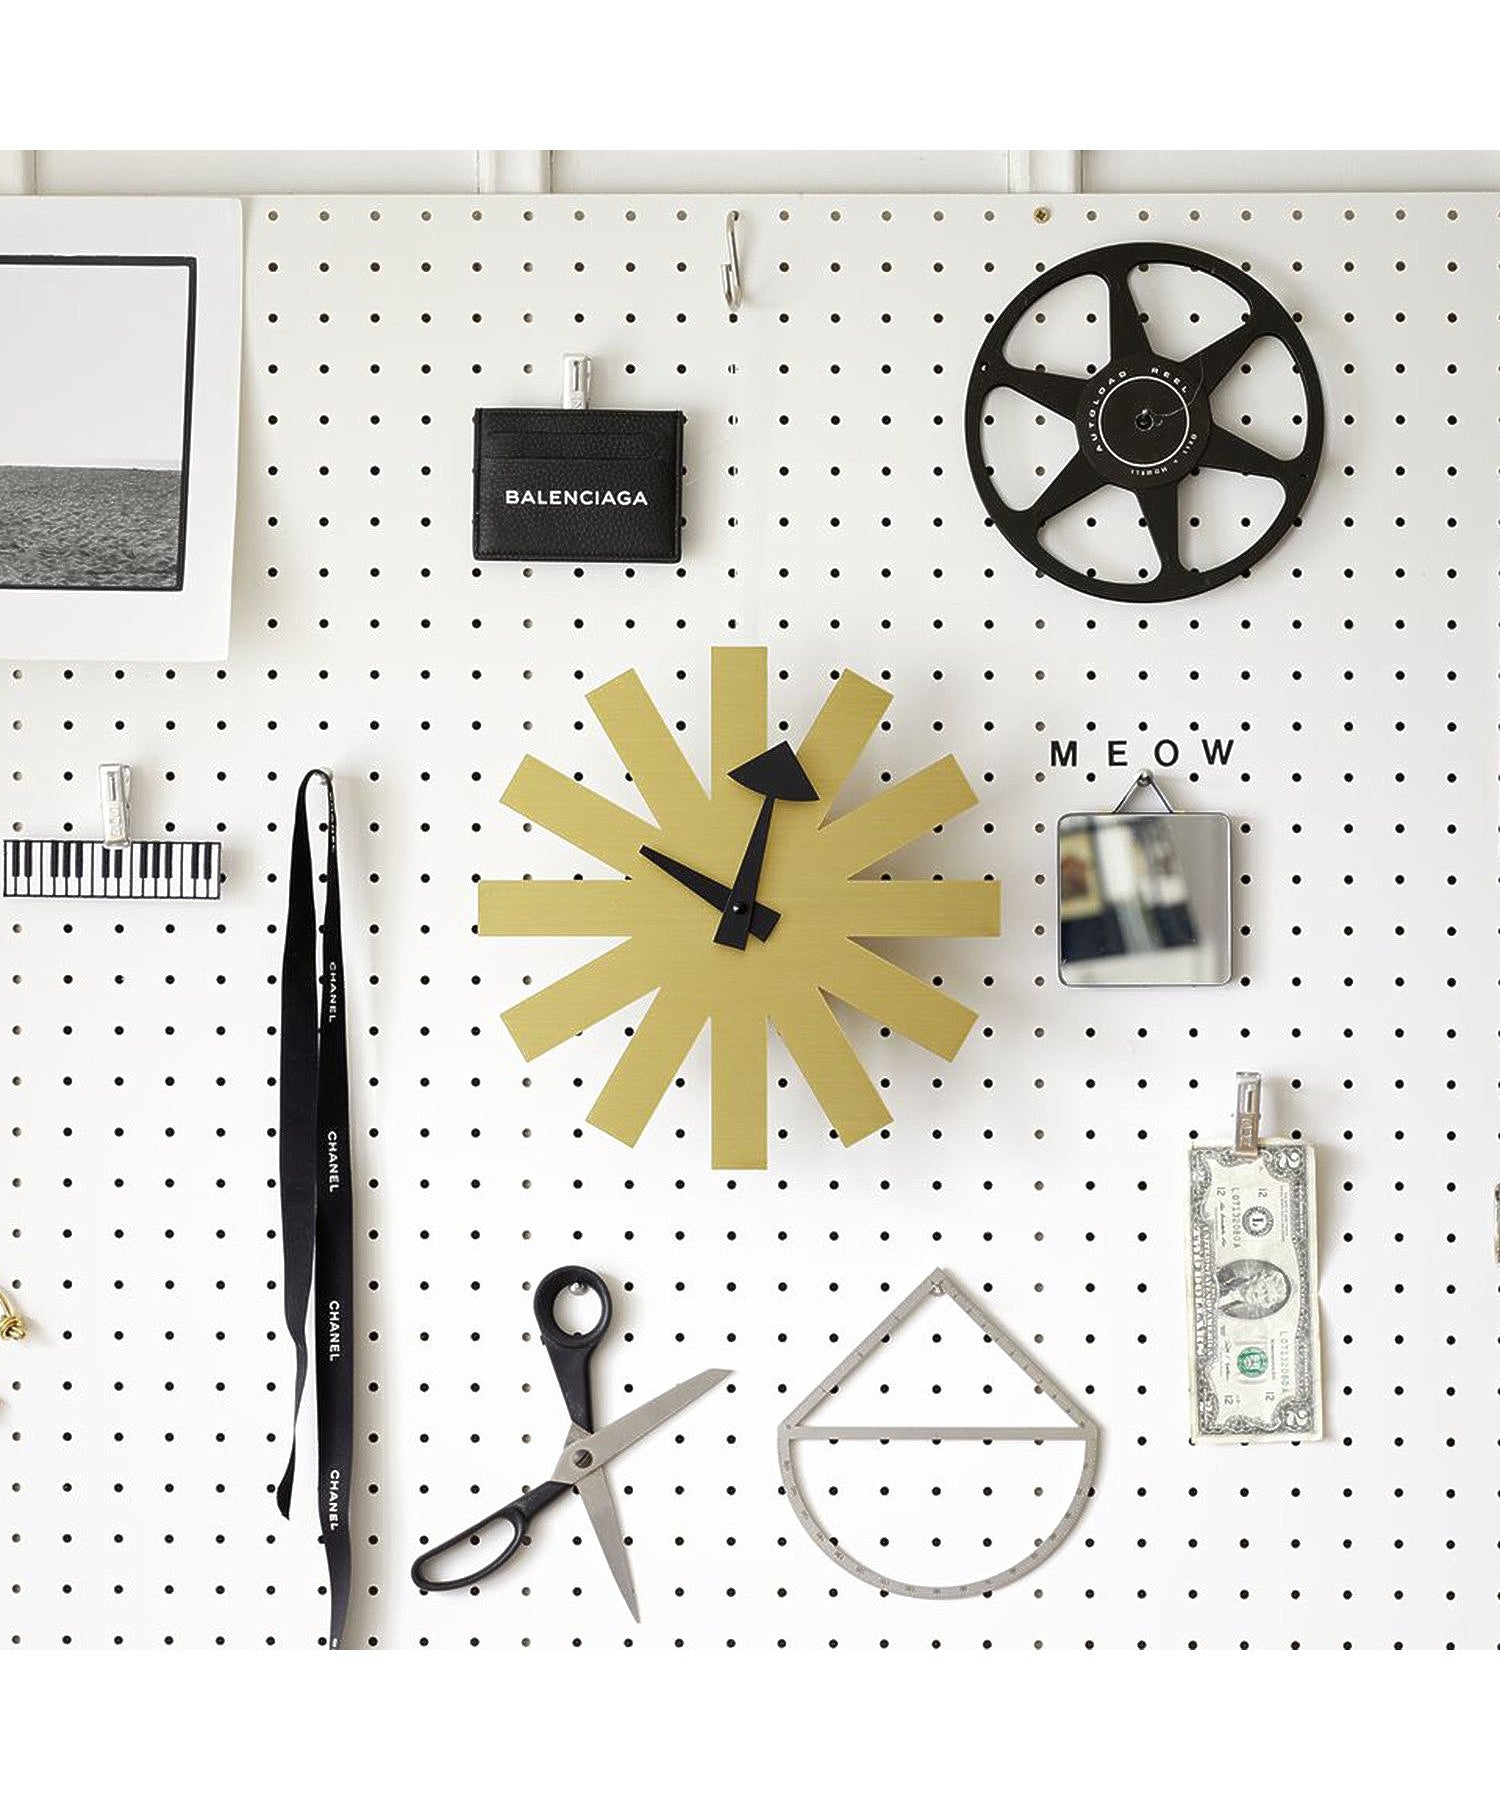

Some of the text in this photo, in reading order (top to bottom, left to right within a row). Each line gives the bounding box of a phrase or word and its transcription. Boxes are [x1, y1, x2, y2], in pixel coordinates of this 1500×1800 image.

[1088, 367, 1188, 453] AUTOLOAD REEL
[505, 490, 649, 506] BALENCIAGA
[328, 961, 337, 1023] CHANEL
[327, 1130, 339, 1193] CHANEL
[1278, 1149, 1301, 1169] 2
[328, 1300, 340, 1362] CHANEL
[1284, 1408, 1308, 1427] 2
[328, 1469, 340, 1531] CHANEL
